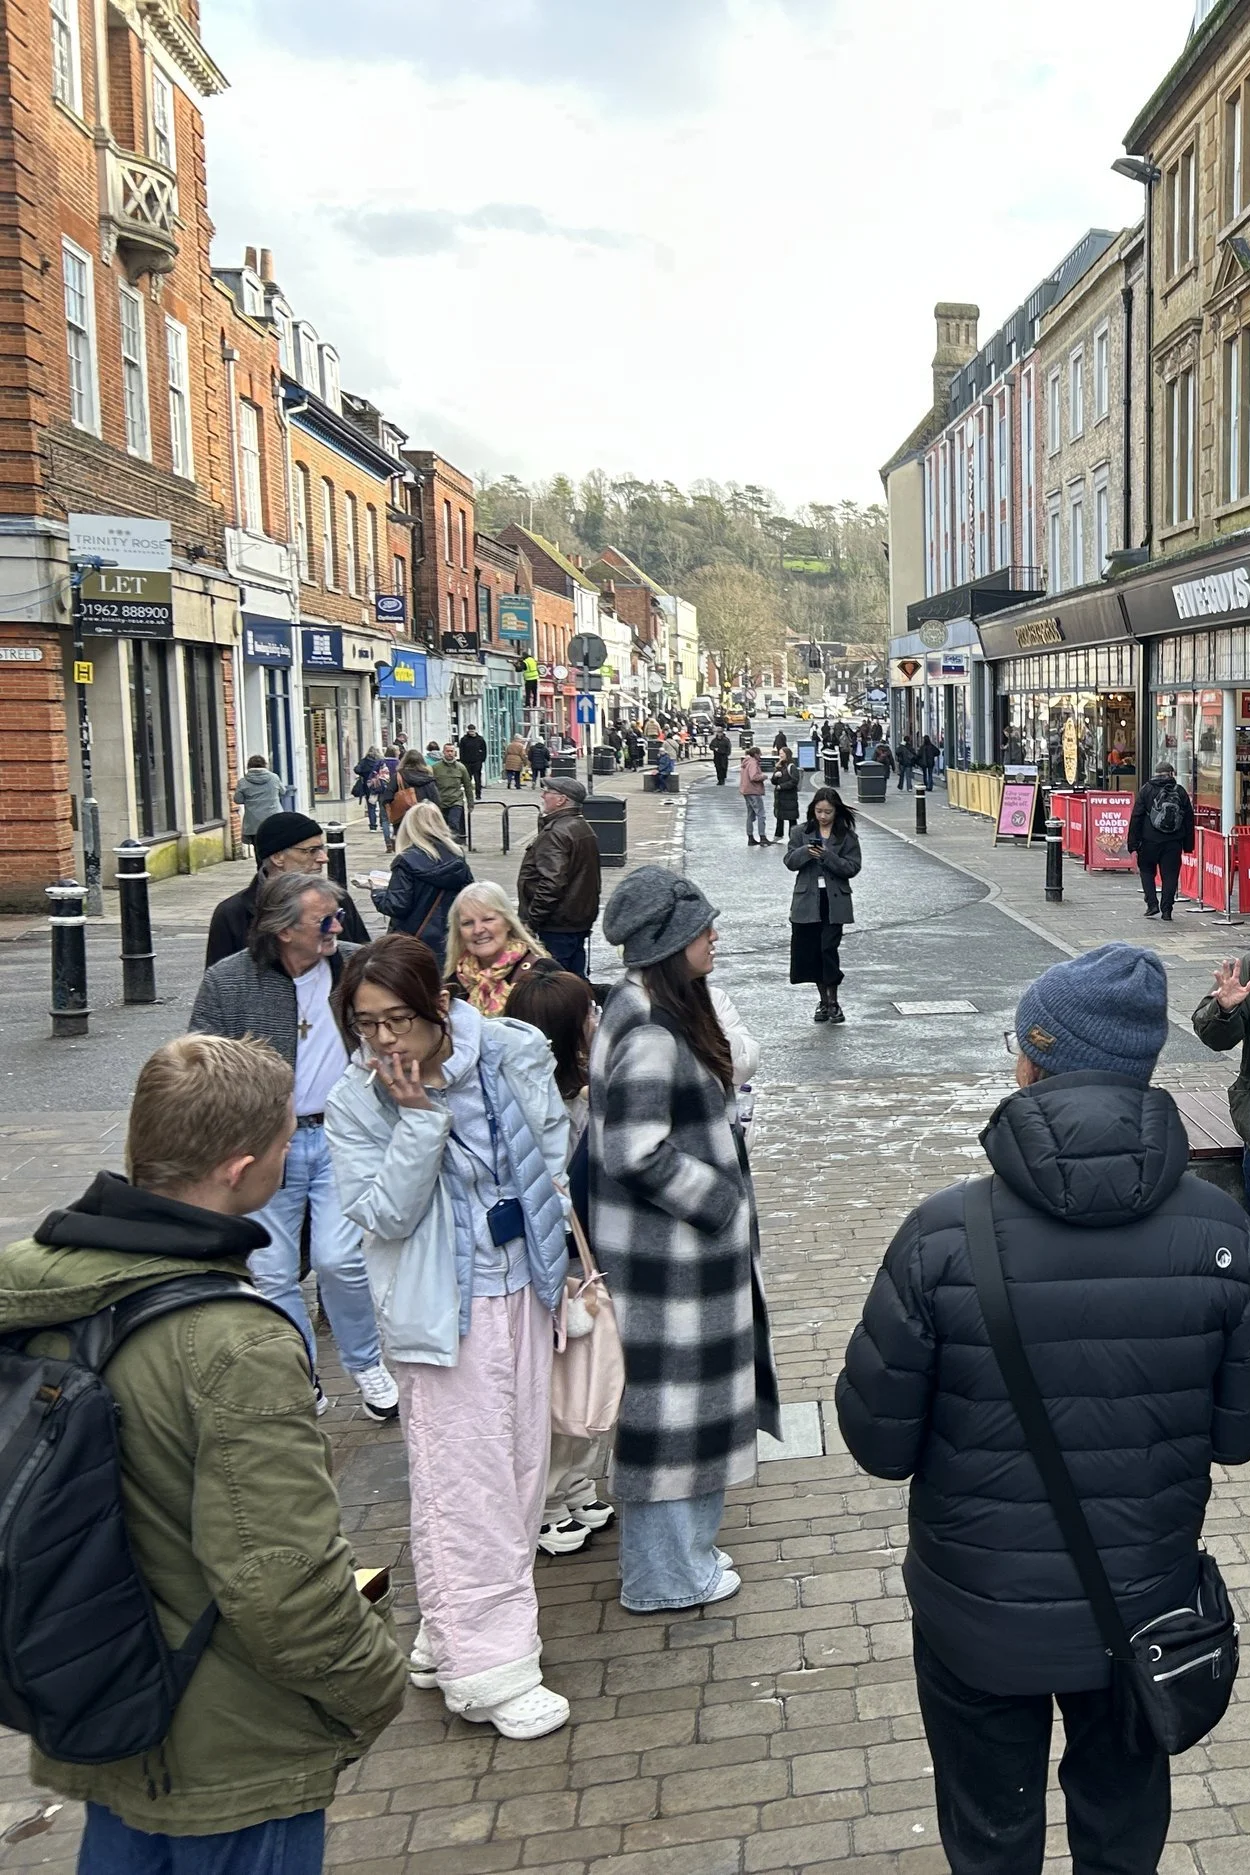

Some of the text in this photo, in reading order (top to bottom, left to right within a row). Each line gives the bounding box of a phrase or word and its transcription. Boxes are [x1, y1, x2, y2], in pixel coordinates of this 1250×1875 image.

[75, 534, 167, 550] TRINITY ROSE
[99, 574, 148, 595] LET
[1171, 578, 1209, 620] FIVE
[122, 605, 169, 619] 888900
[1109, 797, 1131, 805] GUYS
[1095, 819, 1128, 827] LOADED
[1100, 826, 1124, 834] FRIES
